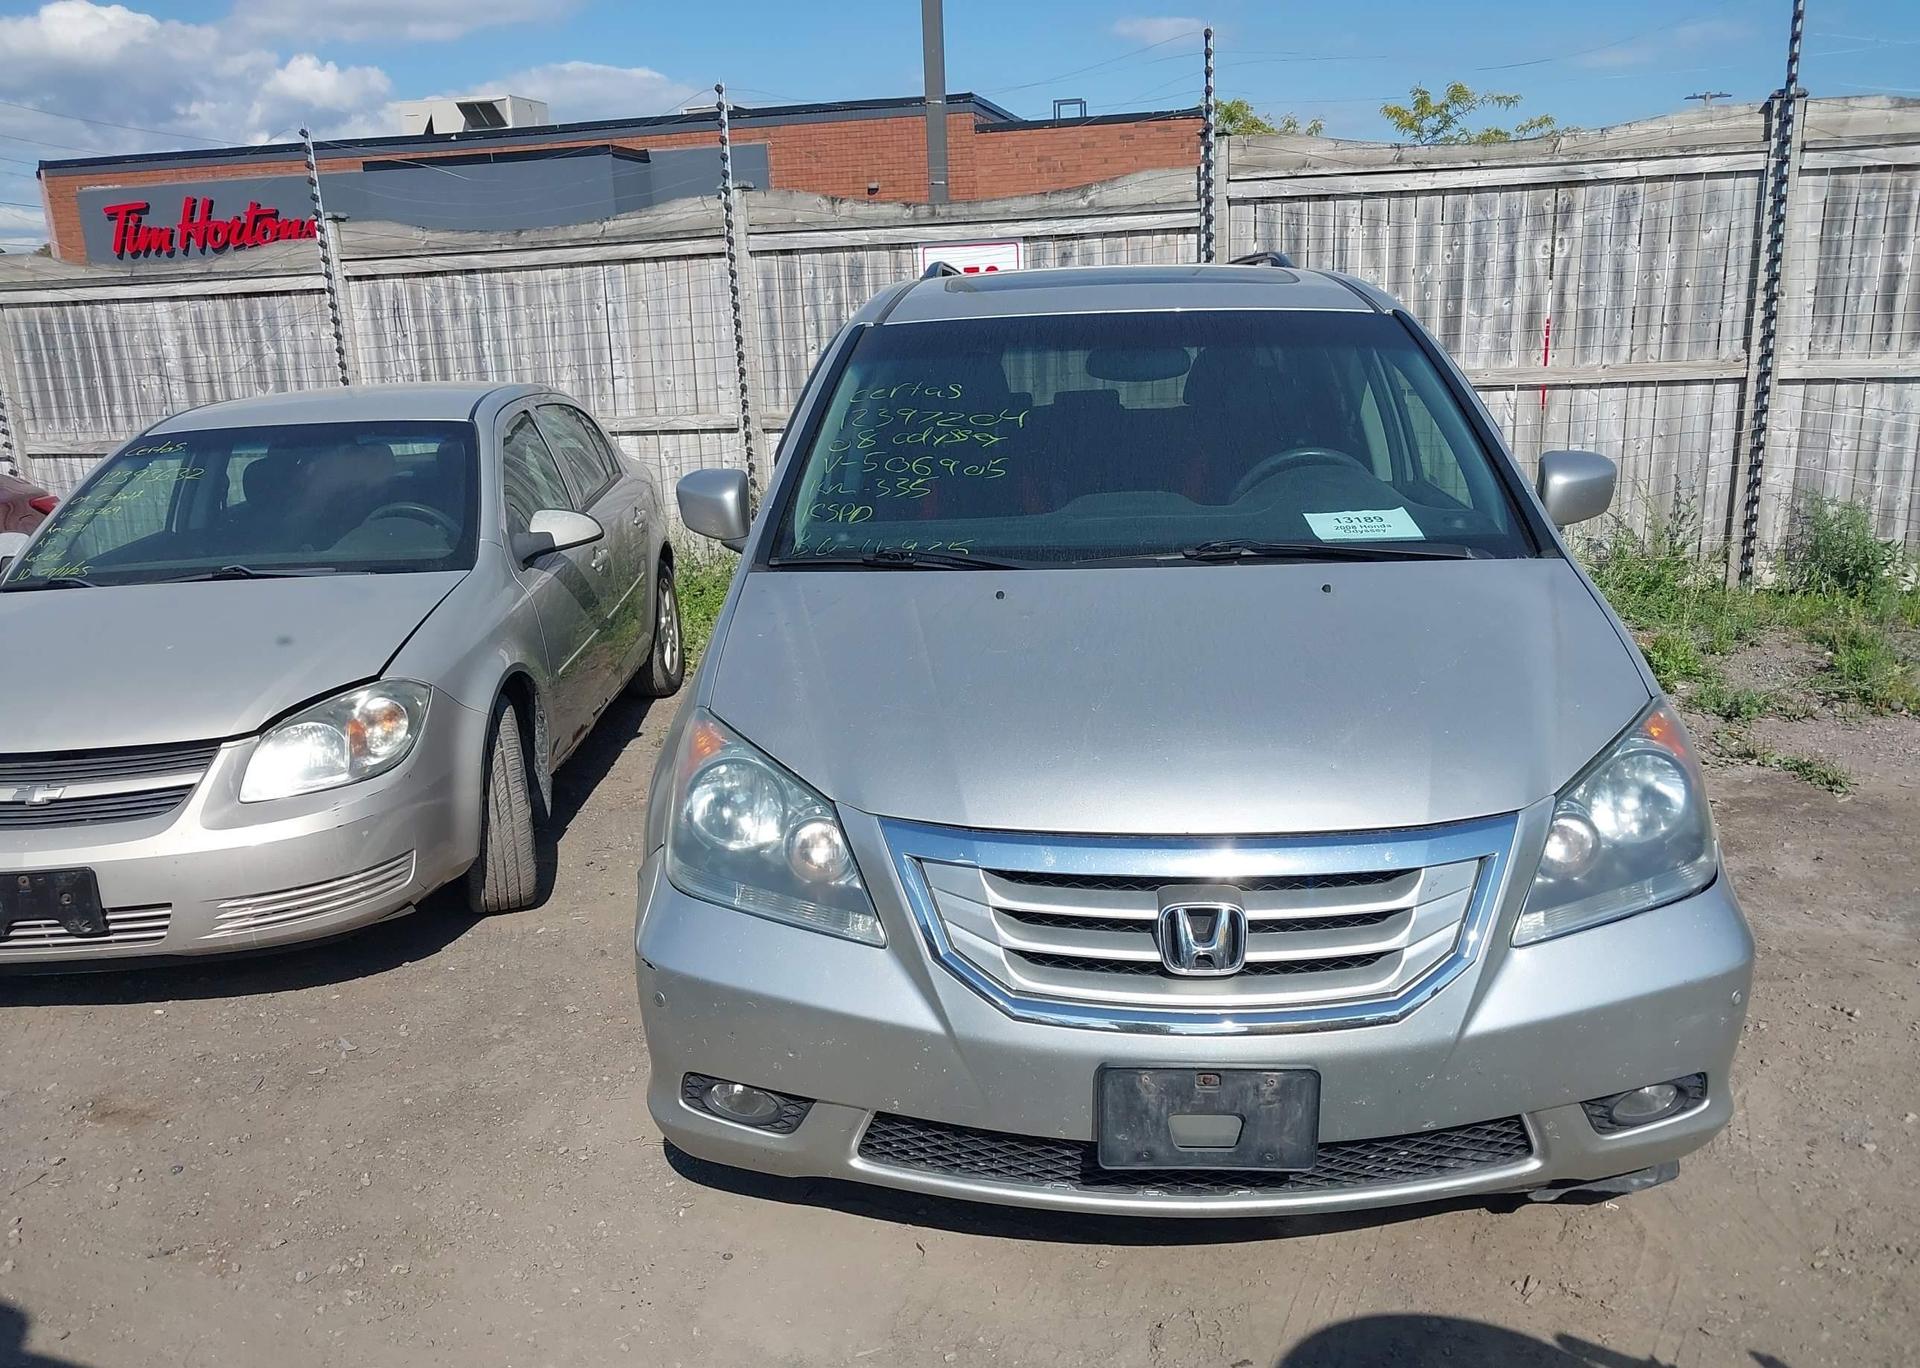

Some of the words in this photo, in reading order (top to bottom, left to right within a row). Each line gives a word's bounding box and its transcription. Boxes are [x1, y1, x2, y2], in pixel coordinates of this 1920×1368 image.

[102, 201, 175, 256] Tim
[177, 196, 318, 251] Hortons
[1333, 515, 1384, 524] 13189
